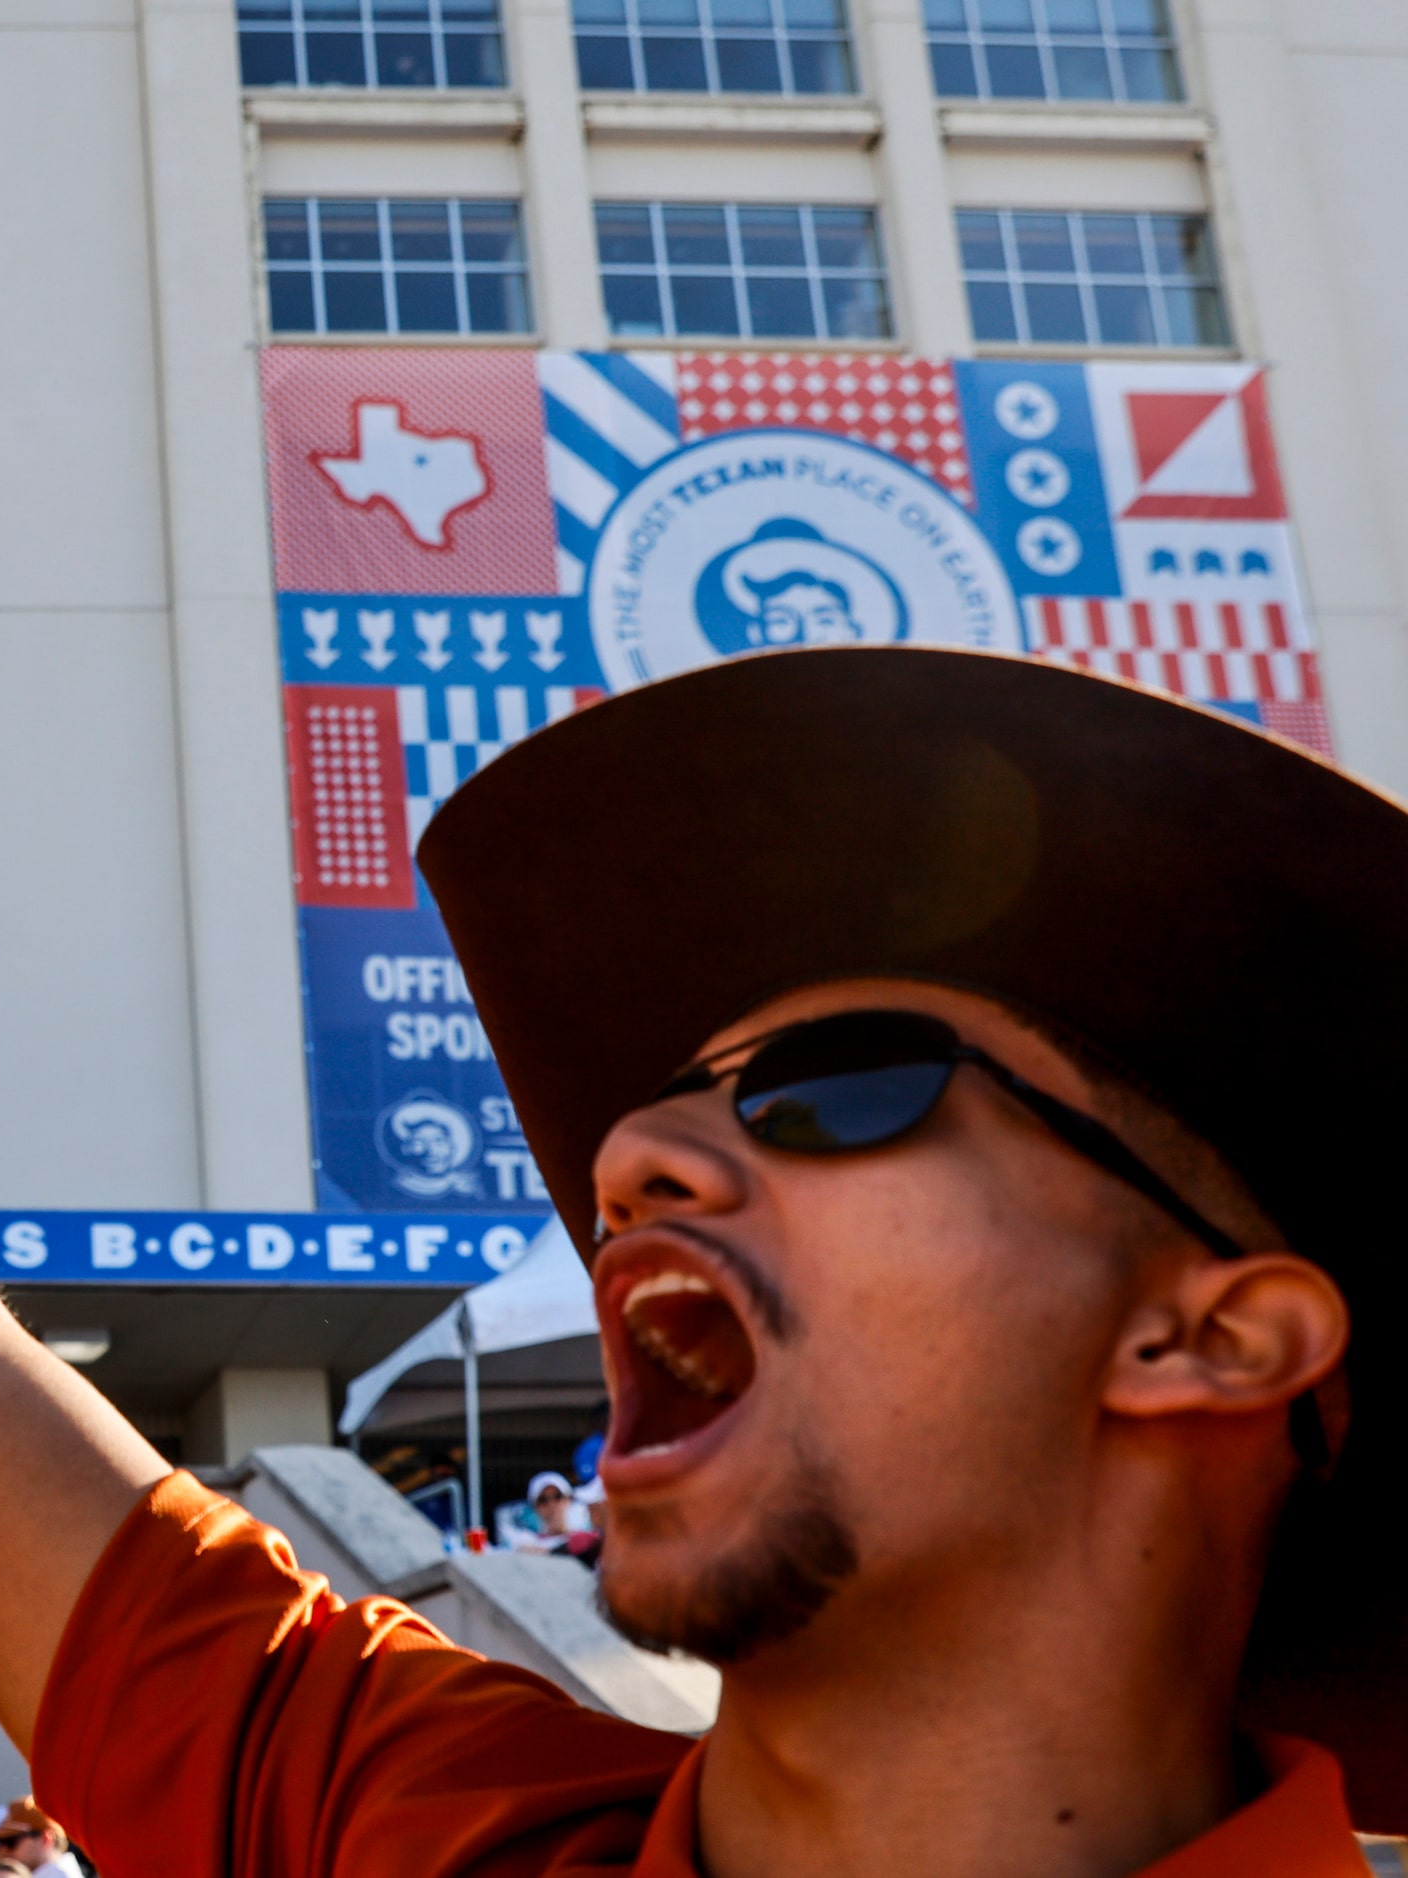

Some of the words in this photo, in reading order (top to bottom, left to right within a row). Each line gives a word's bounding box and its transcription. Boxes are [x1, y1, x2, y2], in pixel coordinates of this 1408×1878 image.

[670, 456, 787, 507] TEXAN
[792, 454, 900, 512] PLACE
[621, 498, 677, 578] MOST
[899, 501, 949, 549] ON
[614, 584, 644, 642] THE
